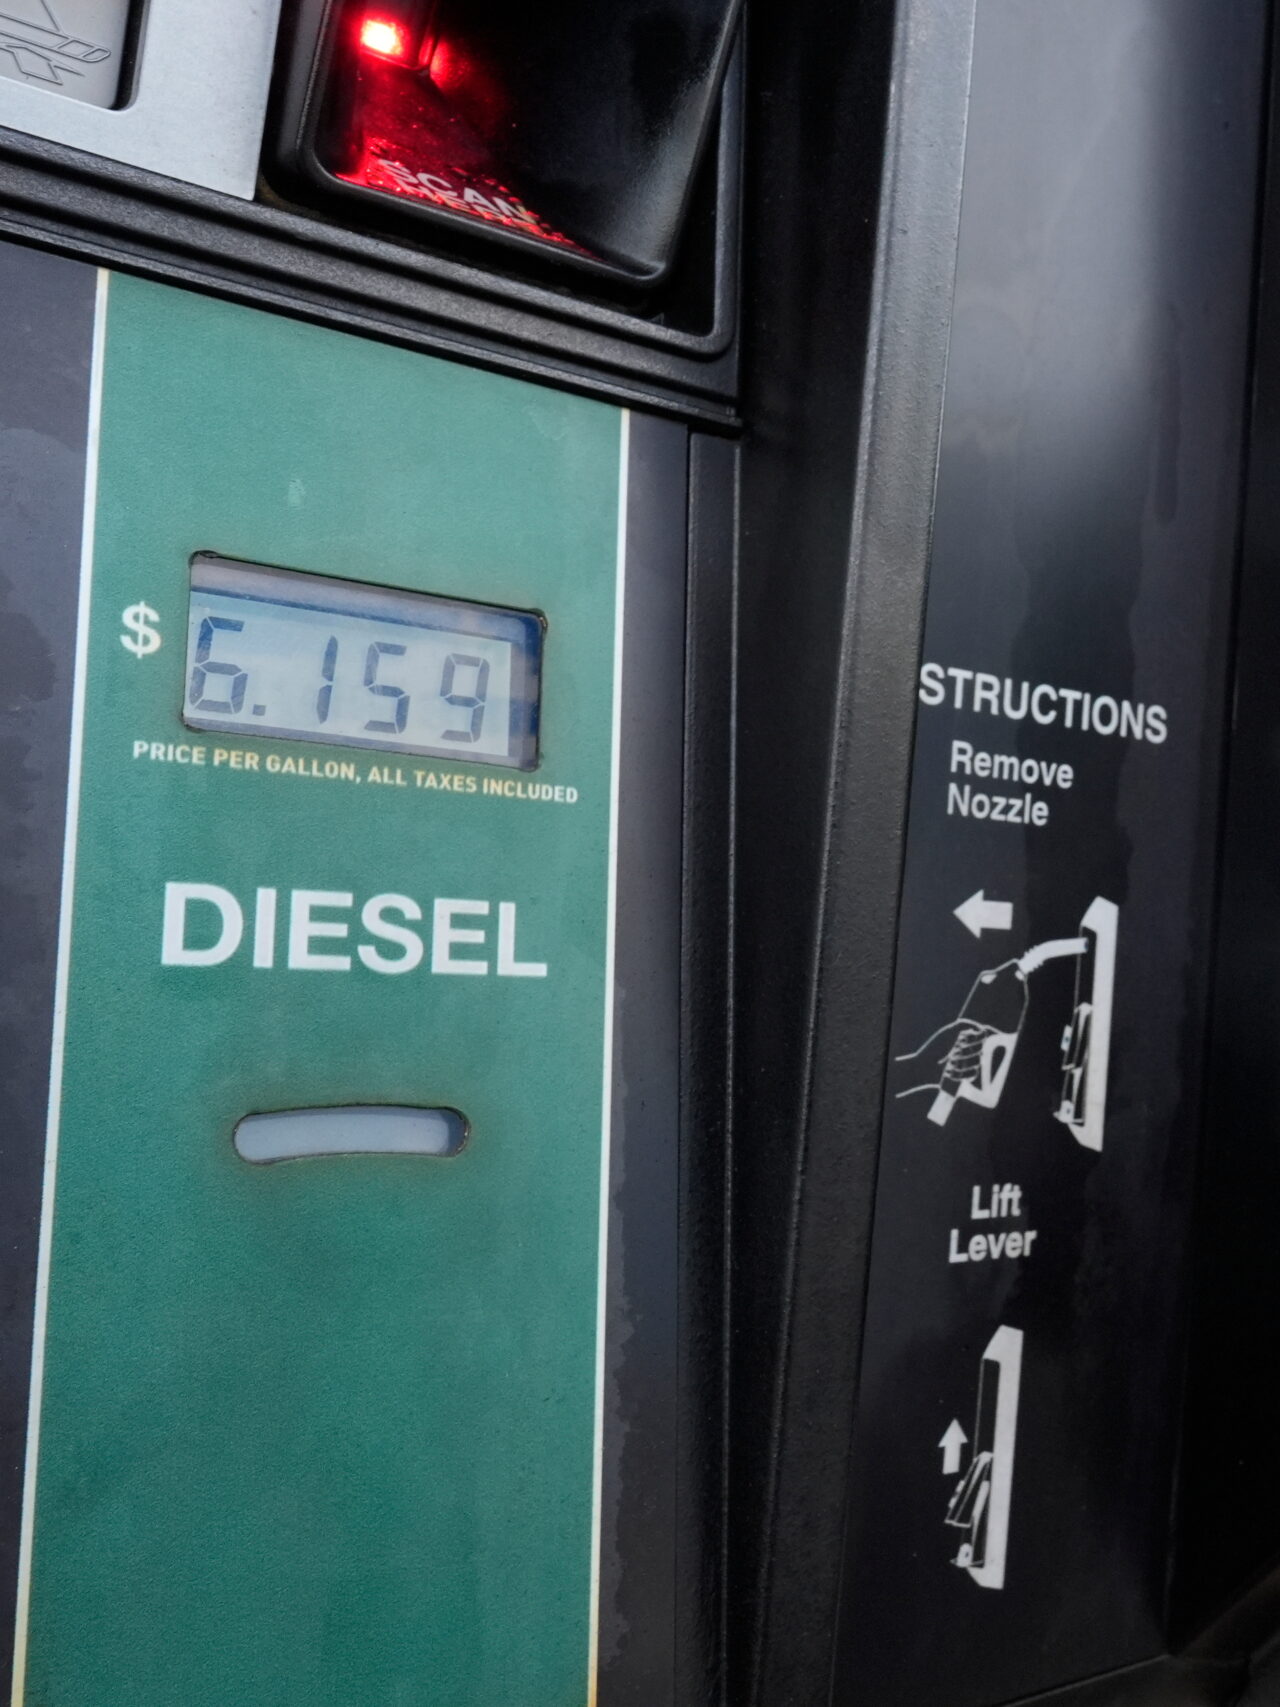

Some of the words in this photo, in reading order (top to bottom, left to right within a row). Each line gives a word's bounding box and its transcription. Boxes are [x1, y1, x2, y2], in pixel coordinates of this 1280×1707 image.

[378, 158, 537, 225] SCAN
[120, 601, 161, 658] $
[189, 616, 490, 743] 6.159
[133, 740, 206, 765] PRICE
[213, 748, 260, 771] PER
[265, 754, 361, 784] GALLON,
[367, 766, 407, 786] ALL
[413, 770, 477, 793] TAXES
[483, 778, 578, 803] INCLUDED
[950, 740, 1074, 789] Remove
[947, 782, 1049, 826] Nozzle
[161, 882, 548, 977] DIESEL
[971, 1183, 1022, 1219] Lift
[949, 1228, 1037, 1263] Lever
